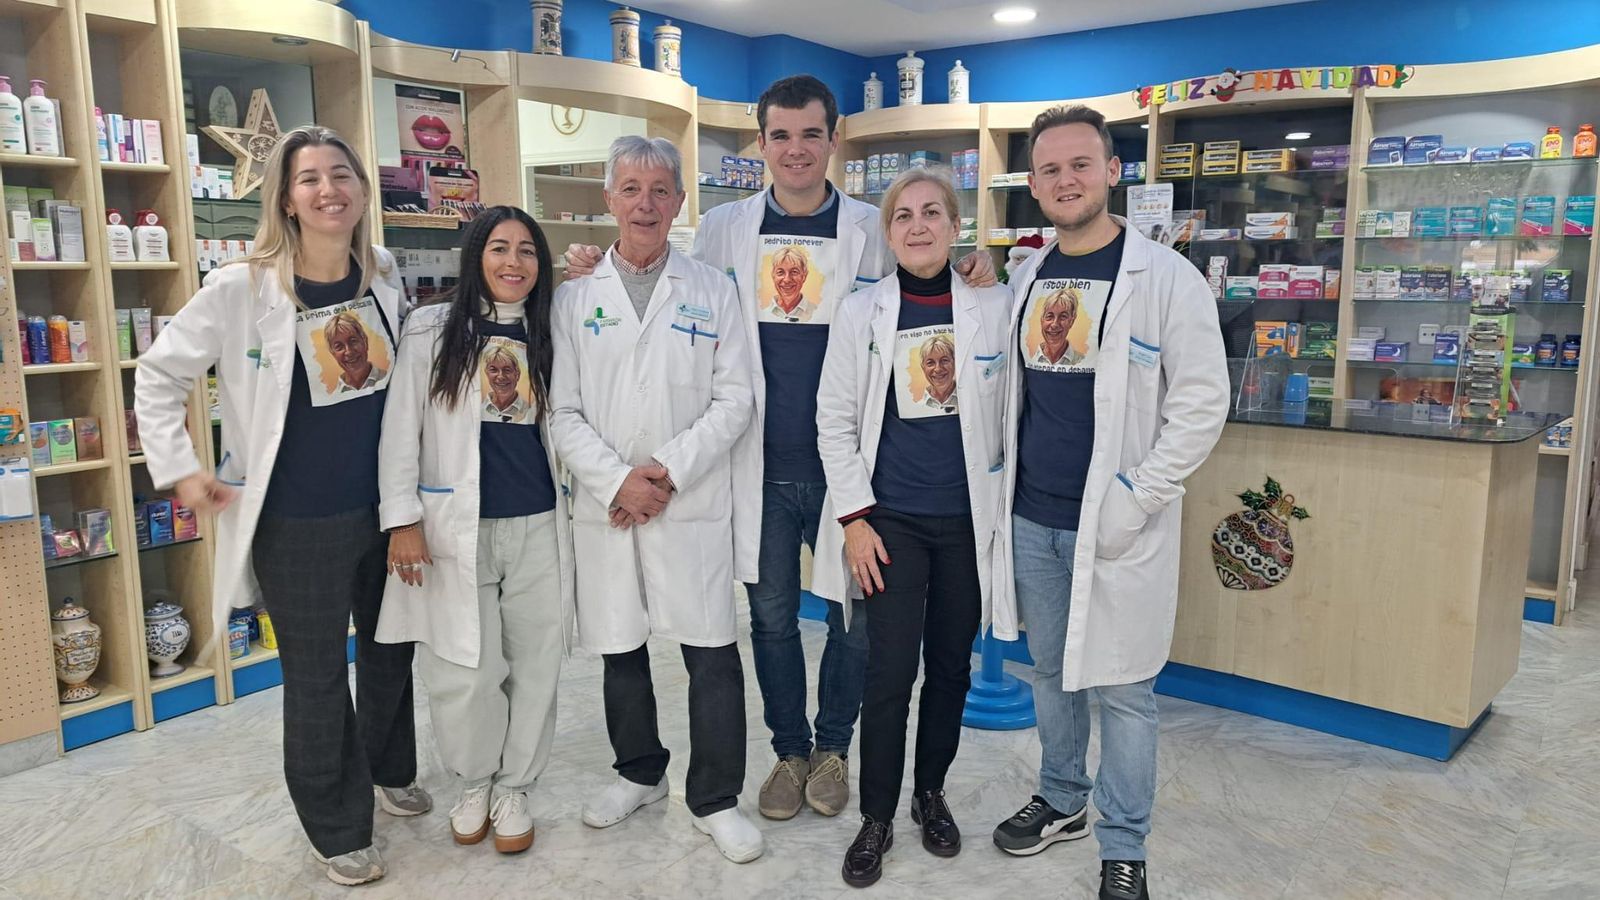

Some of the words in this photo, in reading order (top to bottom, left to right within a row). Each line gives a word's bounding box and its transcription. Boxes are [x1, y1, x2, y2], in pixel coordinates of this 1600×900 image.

[1139, 78, 1206, 108] FELIZ
[1254, 65, 1396, 92] NAVIDAD
[1546, 139, 1560, 147] ENO
[1578, 136, 1592, 144] ENO
[1068, 278, 1091, 291] bien
